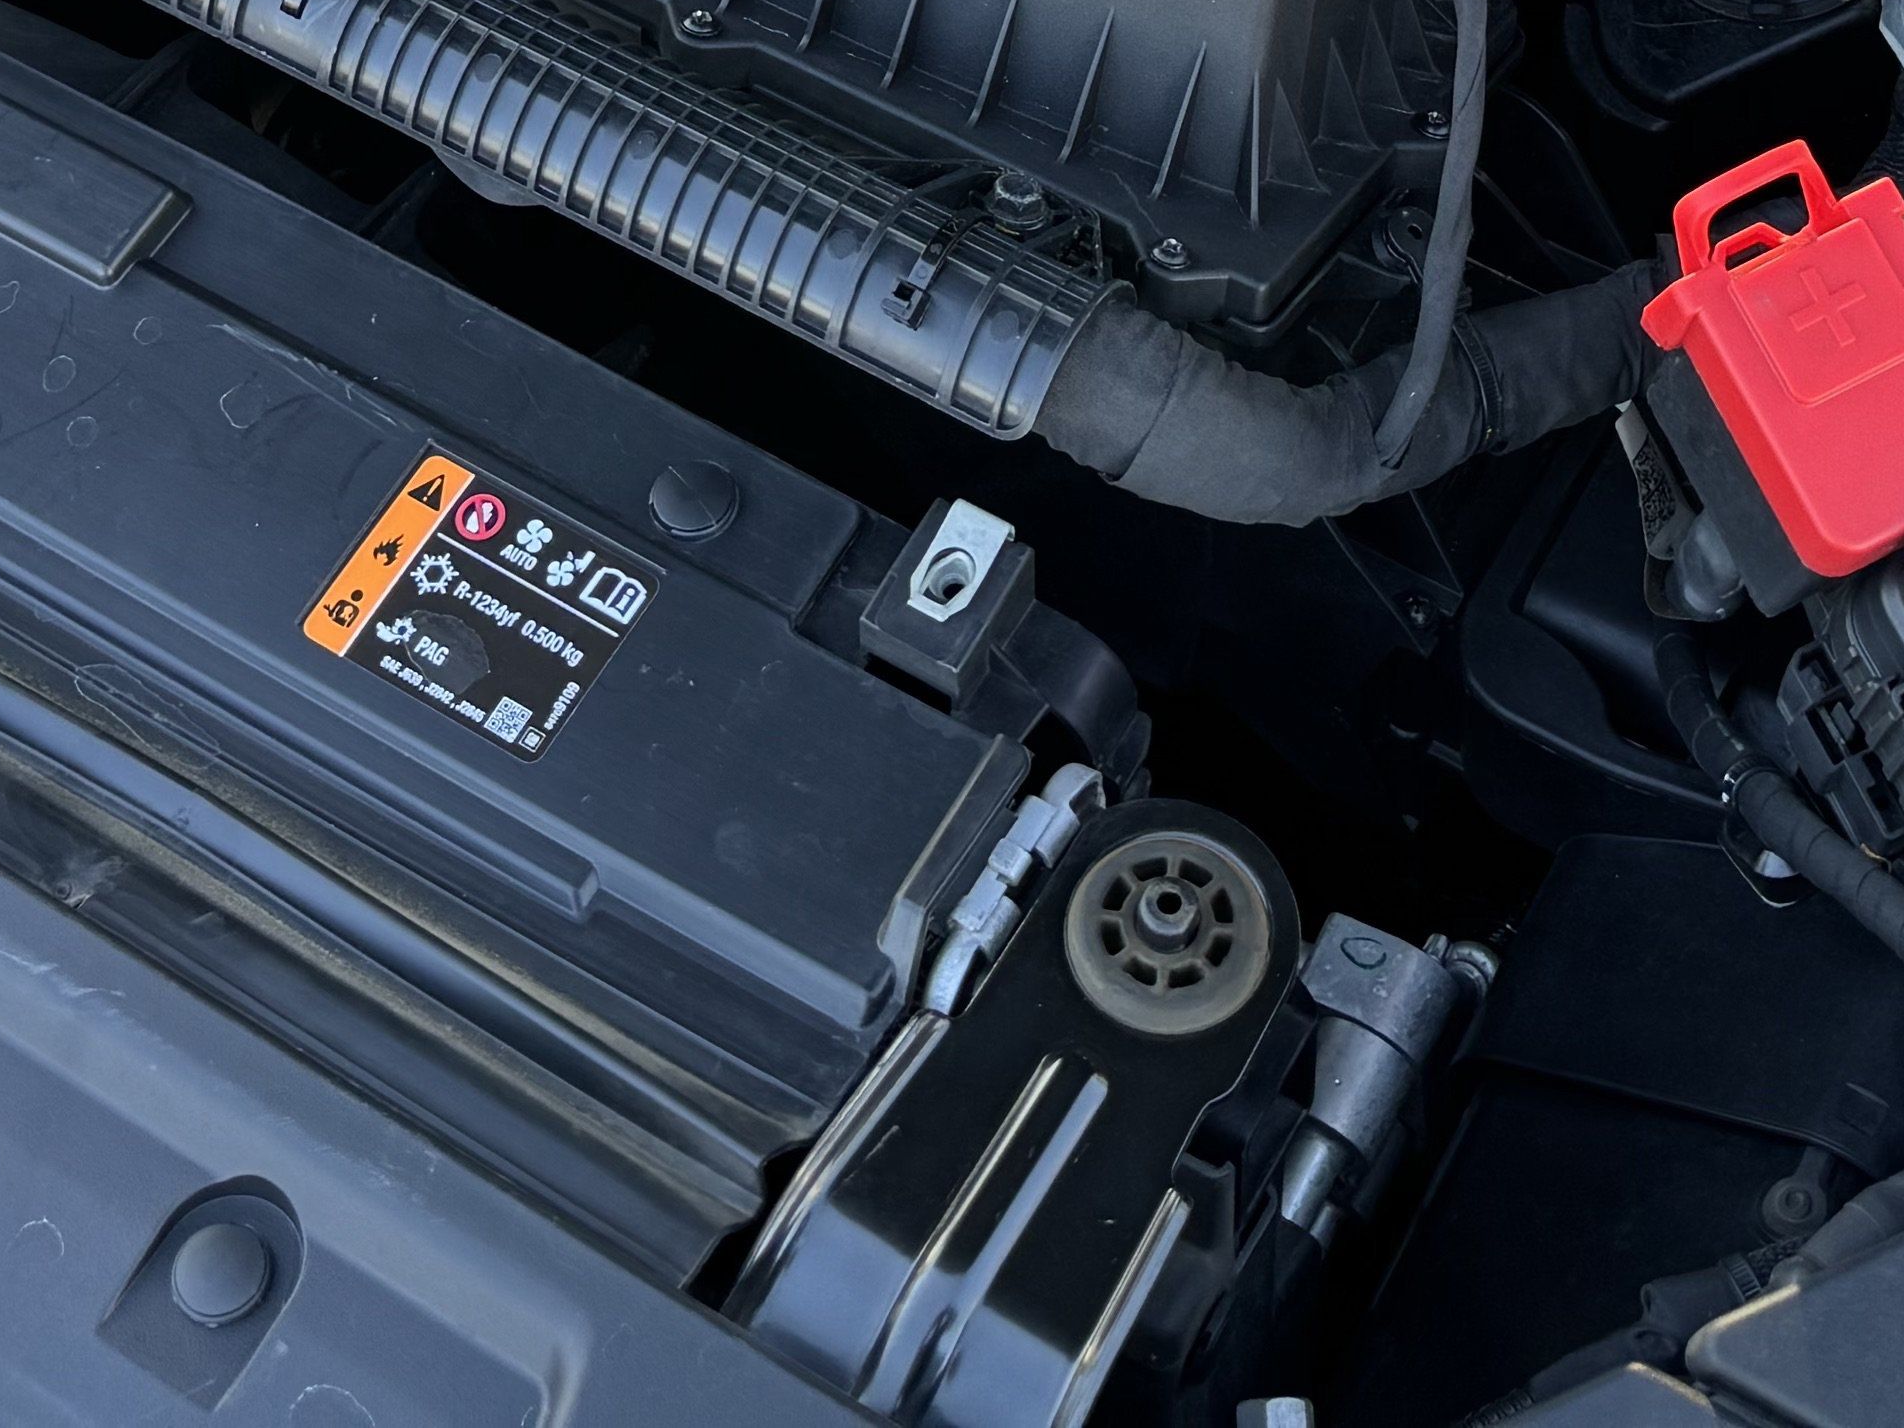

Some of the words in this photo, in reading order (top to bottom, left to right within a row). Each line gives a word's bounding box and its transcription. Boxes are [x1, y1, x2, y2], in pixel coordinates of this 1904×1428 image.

[500, 543, 538, 571] AUTO
[452, 580, 521, 630] R-1234yf
[520, 619, 562, 657] 0.500
[560, 637, 586, 668] kg
[413, 635, 450, 666] PAG
